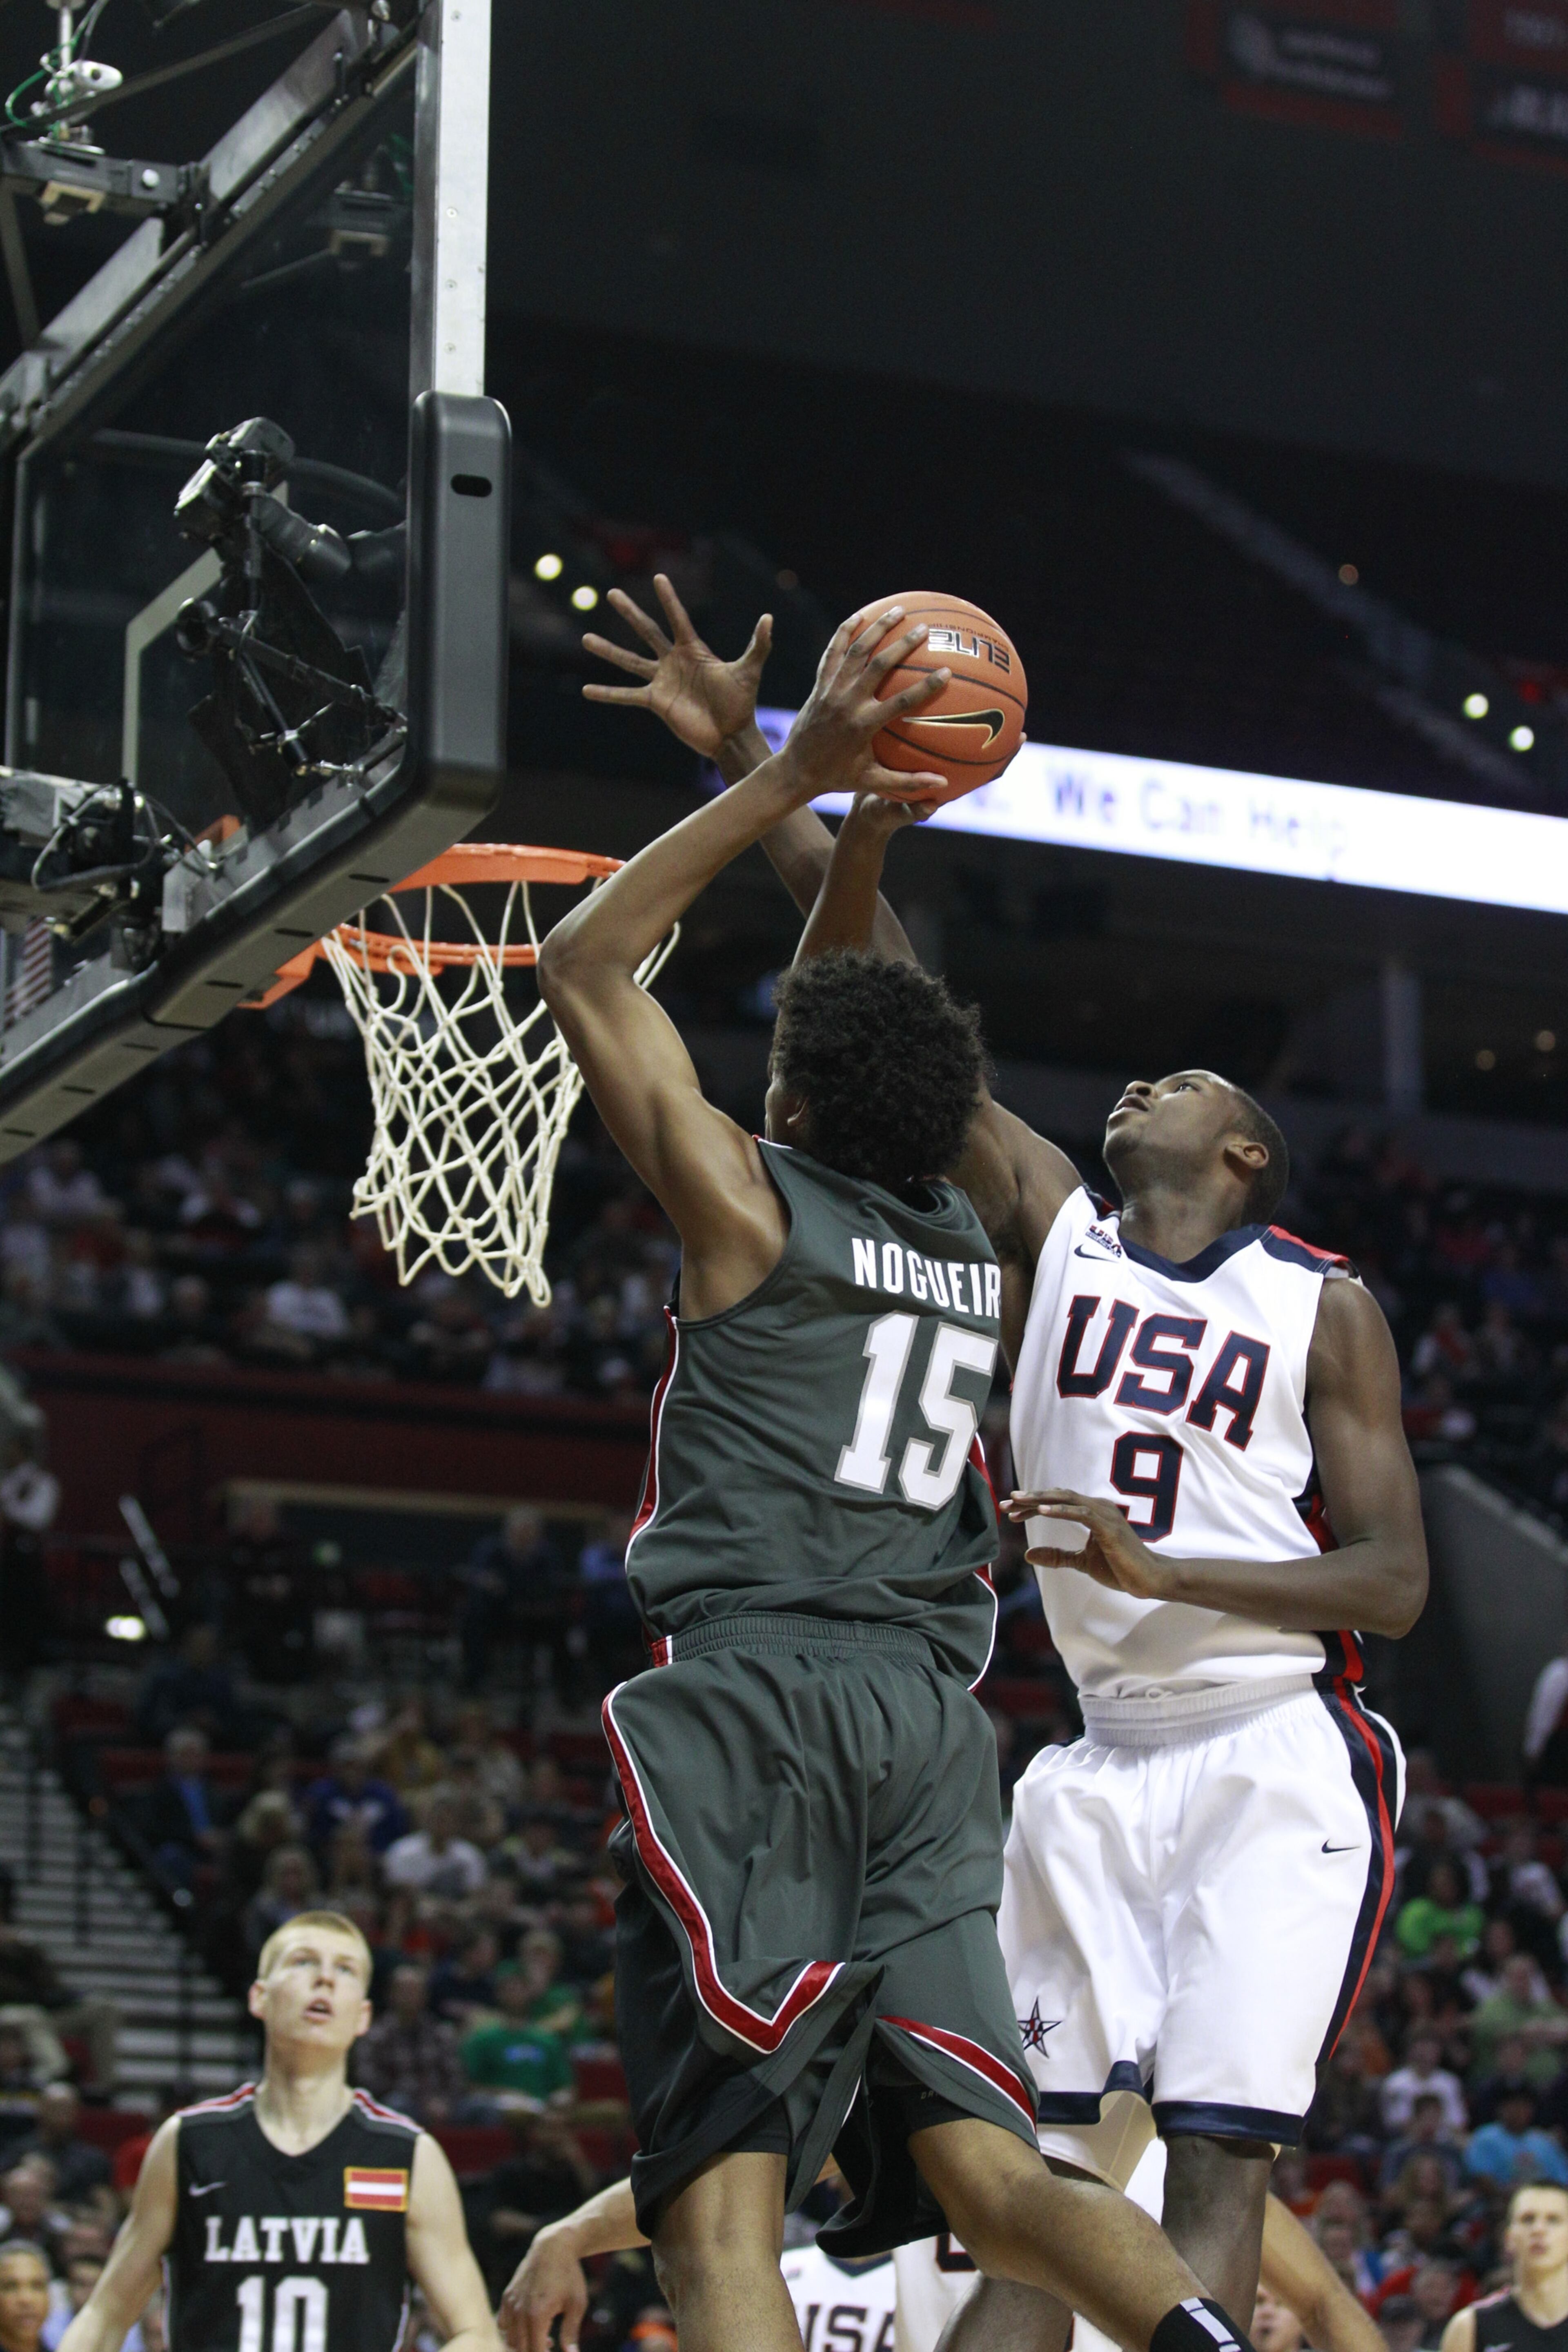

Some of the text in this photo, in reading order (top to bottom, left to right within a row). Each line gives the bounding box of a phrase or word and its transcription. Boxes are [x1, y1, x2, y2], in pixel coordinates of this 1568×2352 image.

[928, 628, 1011, 676] ELITE
[1044, 764, 1121, 829] We
[1138, 774, 1224, 838] Can
[1089, 1225, 1121, 1258] USA
[834, 1310, 999, 1510] 15
[1056, 1295, 1270, 1451] USA
[1109, 1431, 1184, 1543] 9
[203, 2215, 370, 2265] LATVIA
[236, 2274, 329, 2352] 10
